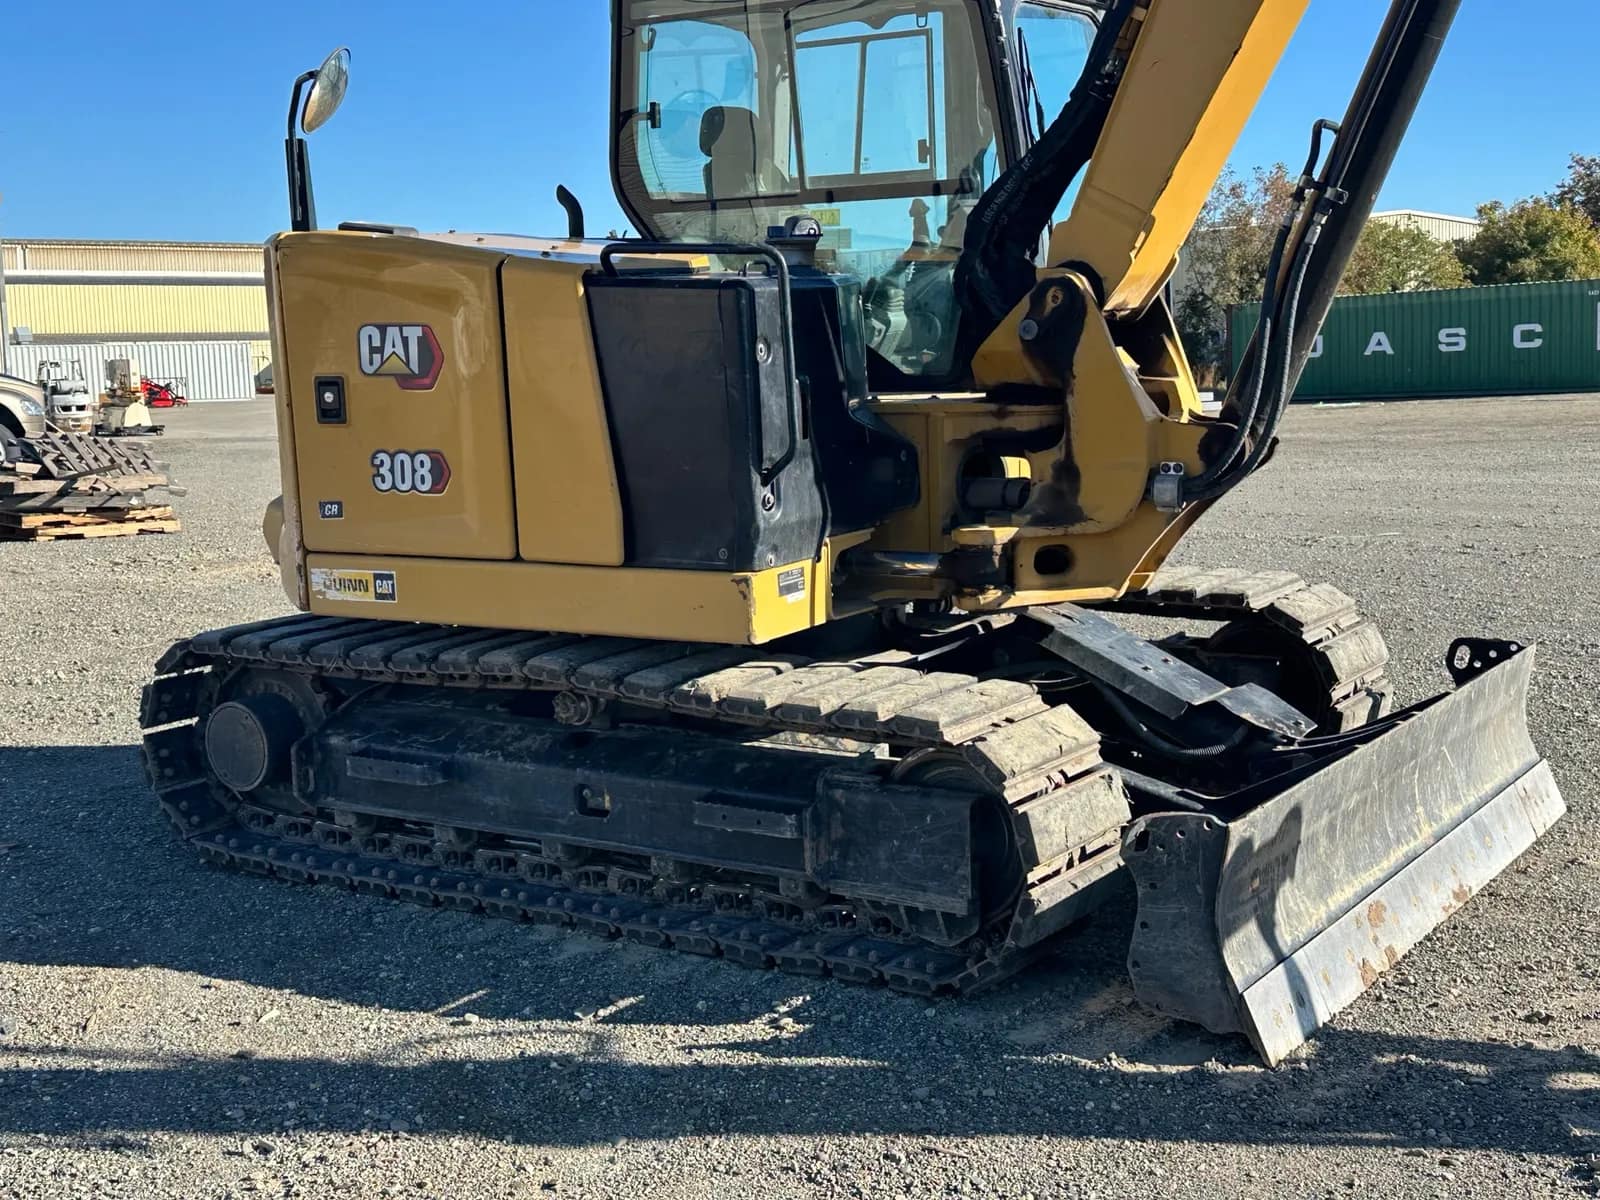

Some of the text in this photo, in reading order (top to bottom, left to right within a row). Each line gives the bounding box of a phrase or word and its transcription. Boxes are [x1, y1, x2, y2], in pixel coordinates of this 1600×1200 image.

[360, 325, 422, 376] CAT
[373, 452, 432, 491] 308
[375, 579, 394, 594] CAT
